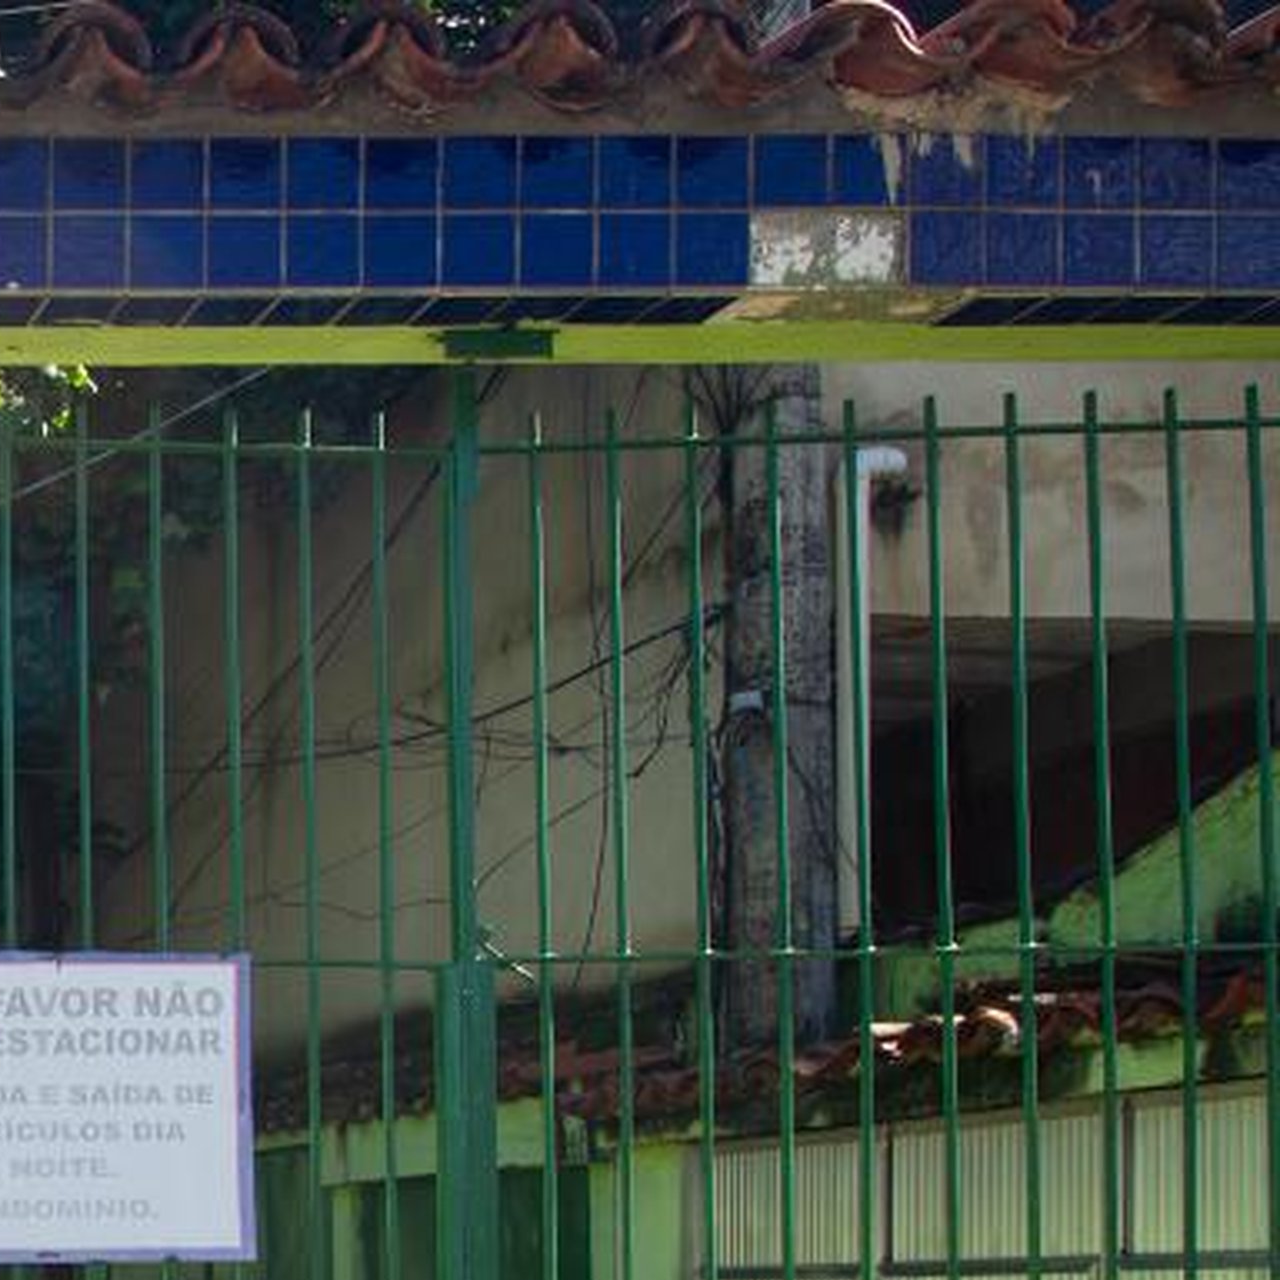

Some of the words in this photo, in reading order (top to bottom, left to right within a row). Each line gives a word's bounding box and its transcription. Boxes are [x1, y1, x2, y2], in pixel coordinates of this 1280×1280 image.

[134, 979, 223, 1018] NÃO
[38, 1084, 60, 1106] E
[68, 1079, 163, 1106] SAÍDA
[175, 1084, 215, 1106] DE
[132, 1120, 187, 1142] DIA
[9, 1156, 118, 1179] NOITE.
